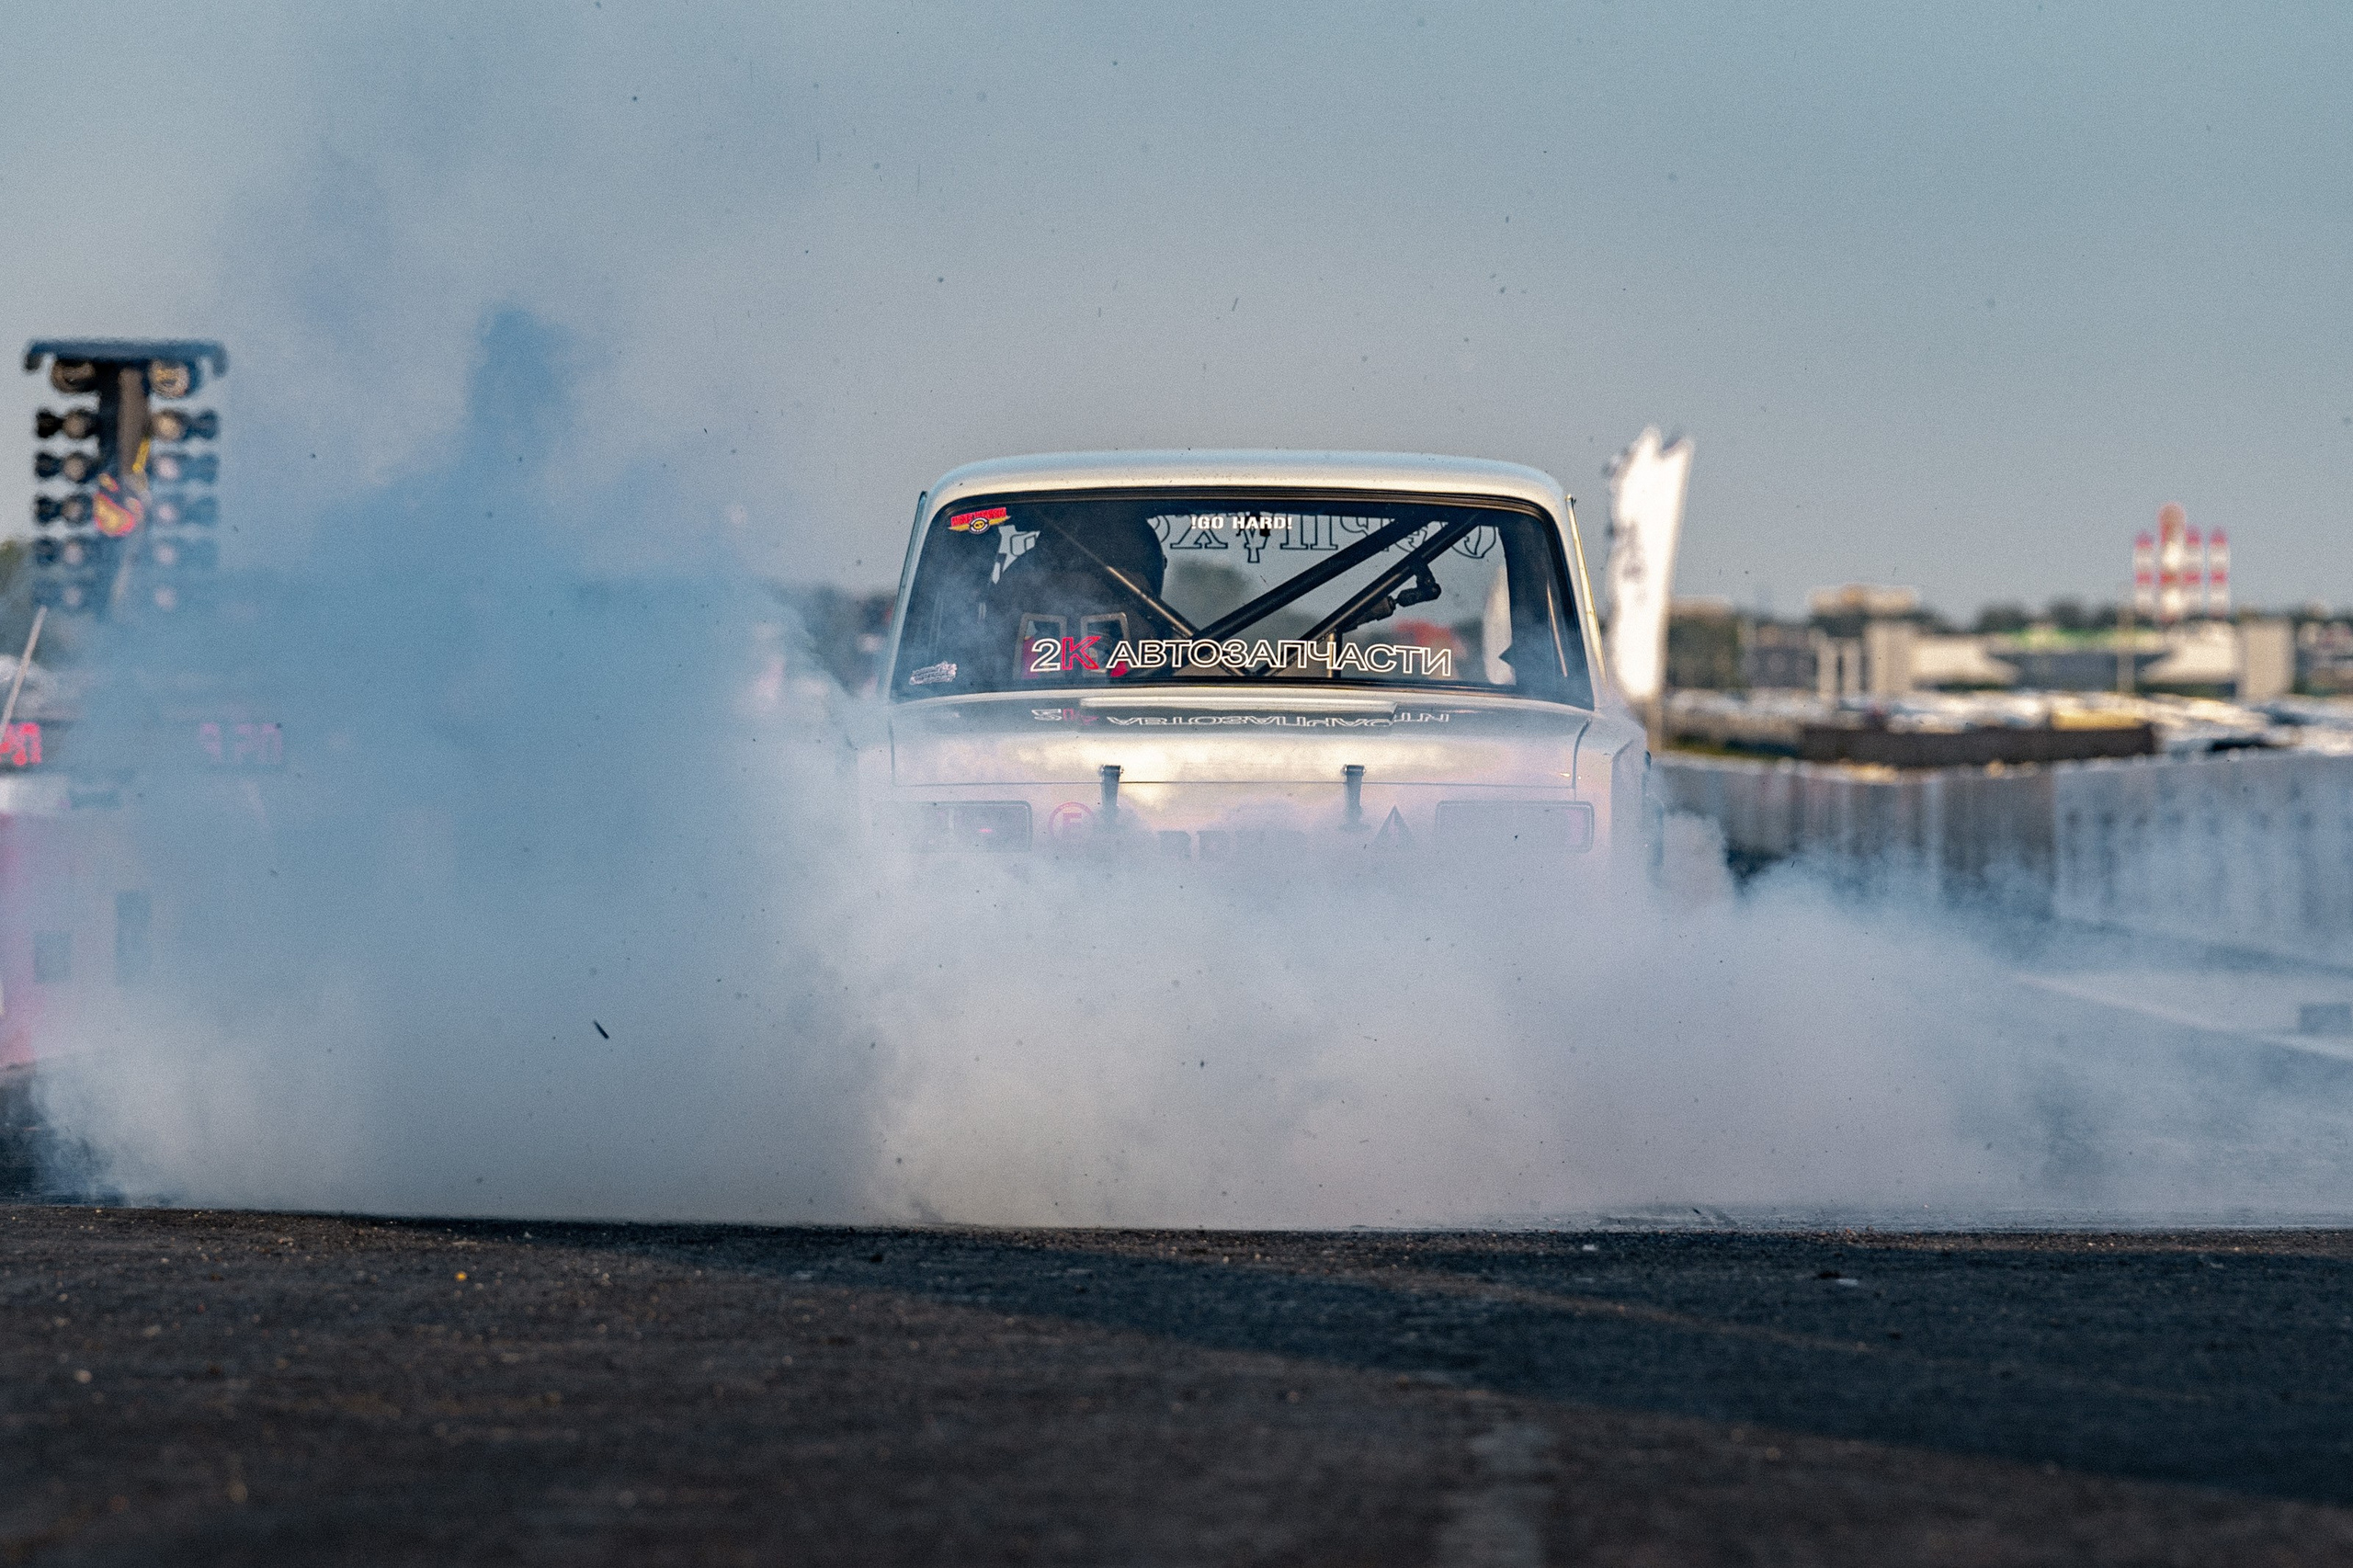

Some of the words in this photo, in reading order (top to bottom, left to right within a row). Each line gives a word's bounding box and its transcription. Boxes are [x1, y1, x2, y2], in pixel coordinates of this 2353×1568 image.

[1191, 516, 1224, 529] !GO
[1233, 516, 1292, 529] HARD!
[1106, 638, 1451, 677] АВТОЗАПЧАСТИ
